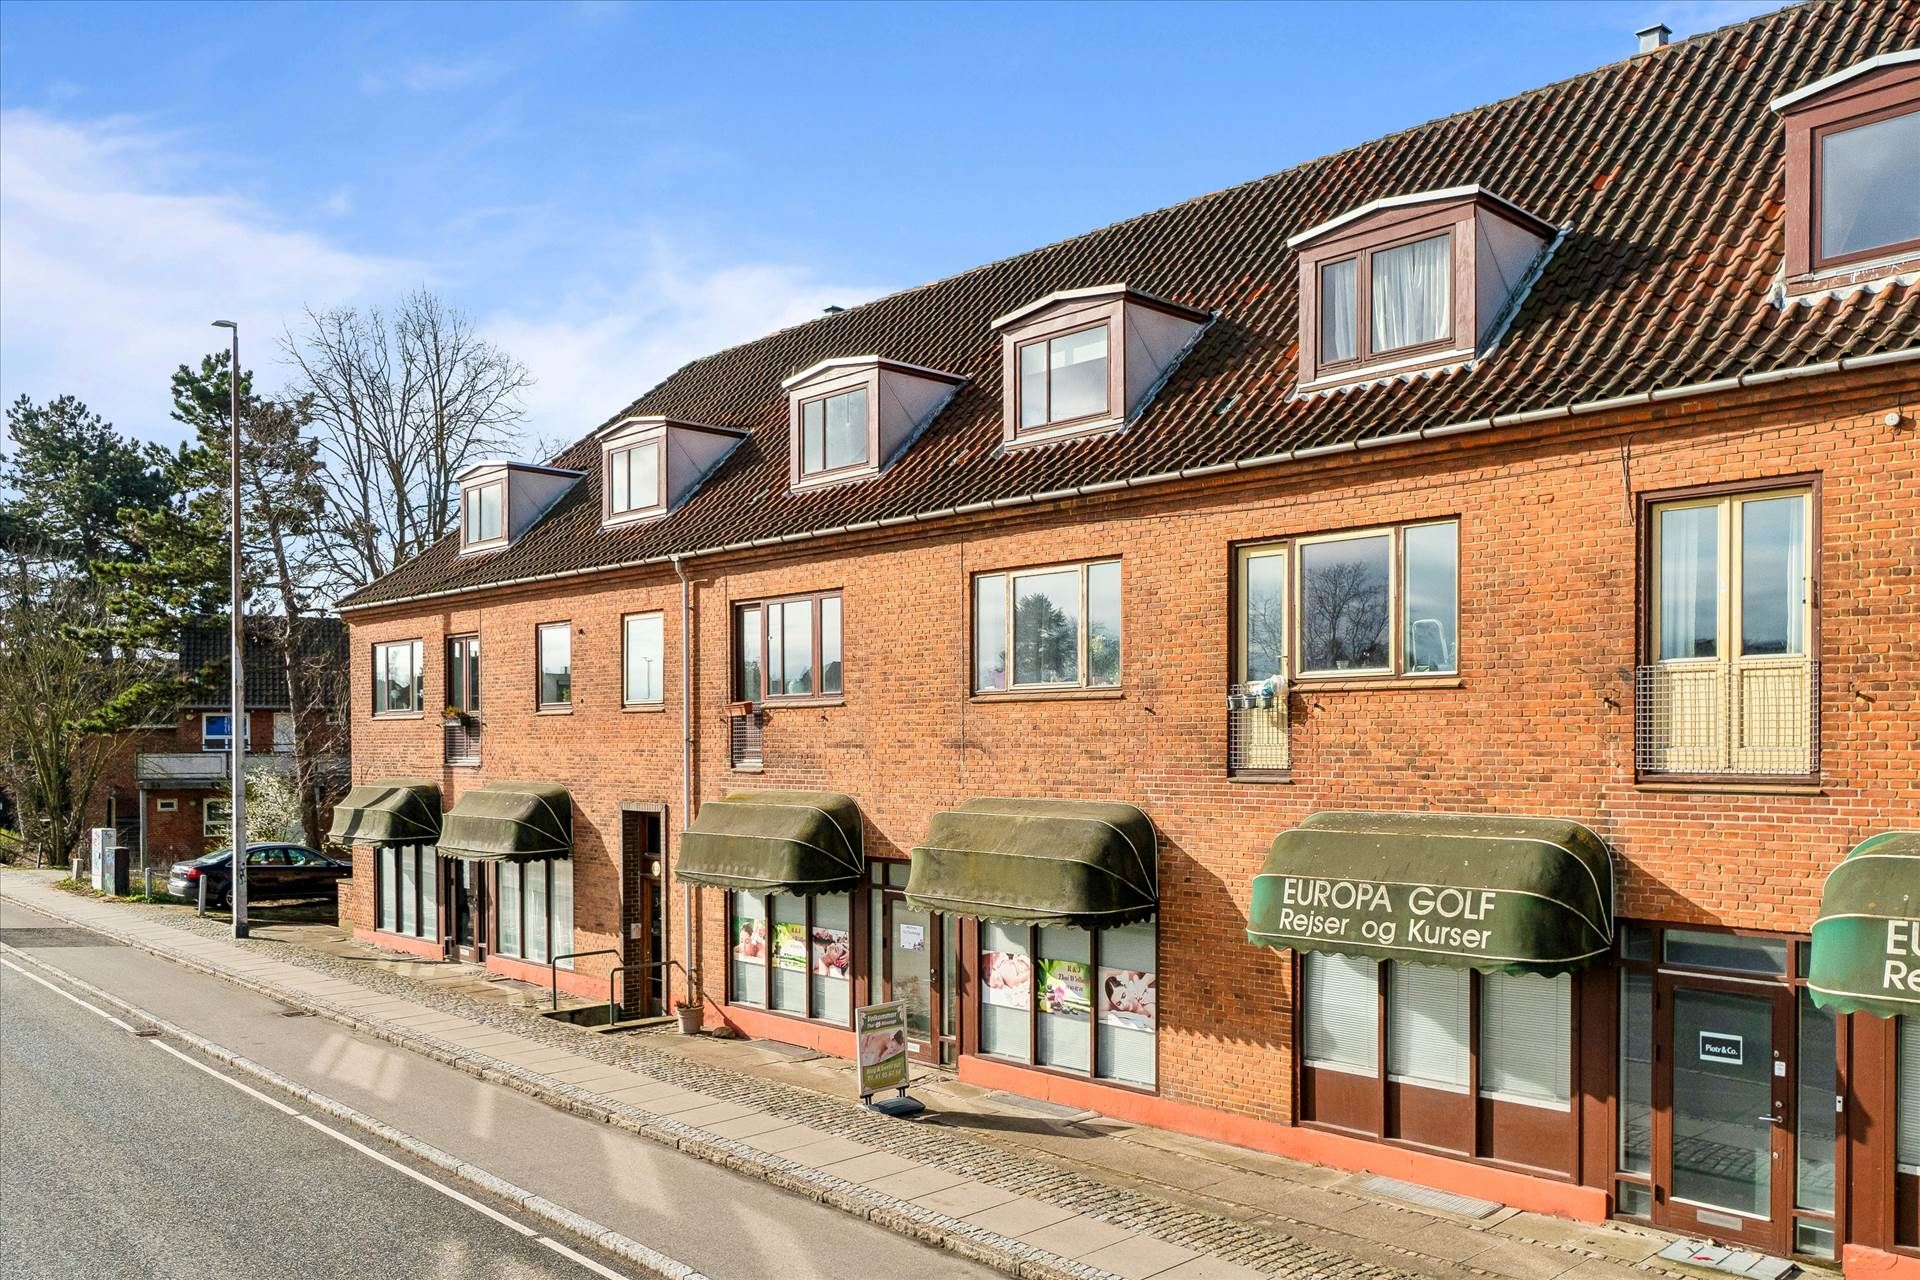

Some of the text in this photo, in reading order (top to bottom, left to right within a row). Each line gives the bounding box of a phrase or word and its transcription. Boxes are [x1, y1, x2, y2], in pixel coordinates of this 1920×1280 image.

[1282, 878, 1497, 921] EUROPA GOLF
[1279, 908, 1492, 949] Rejser og Kurser
